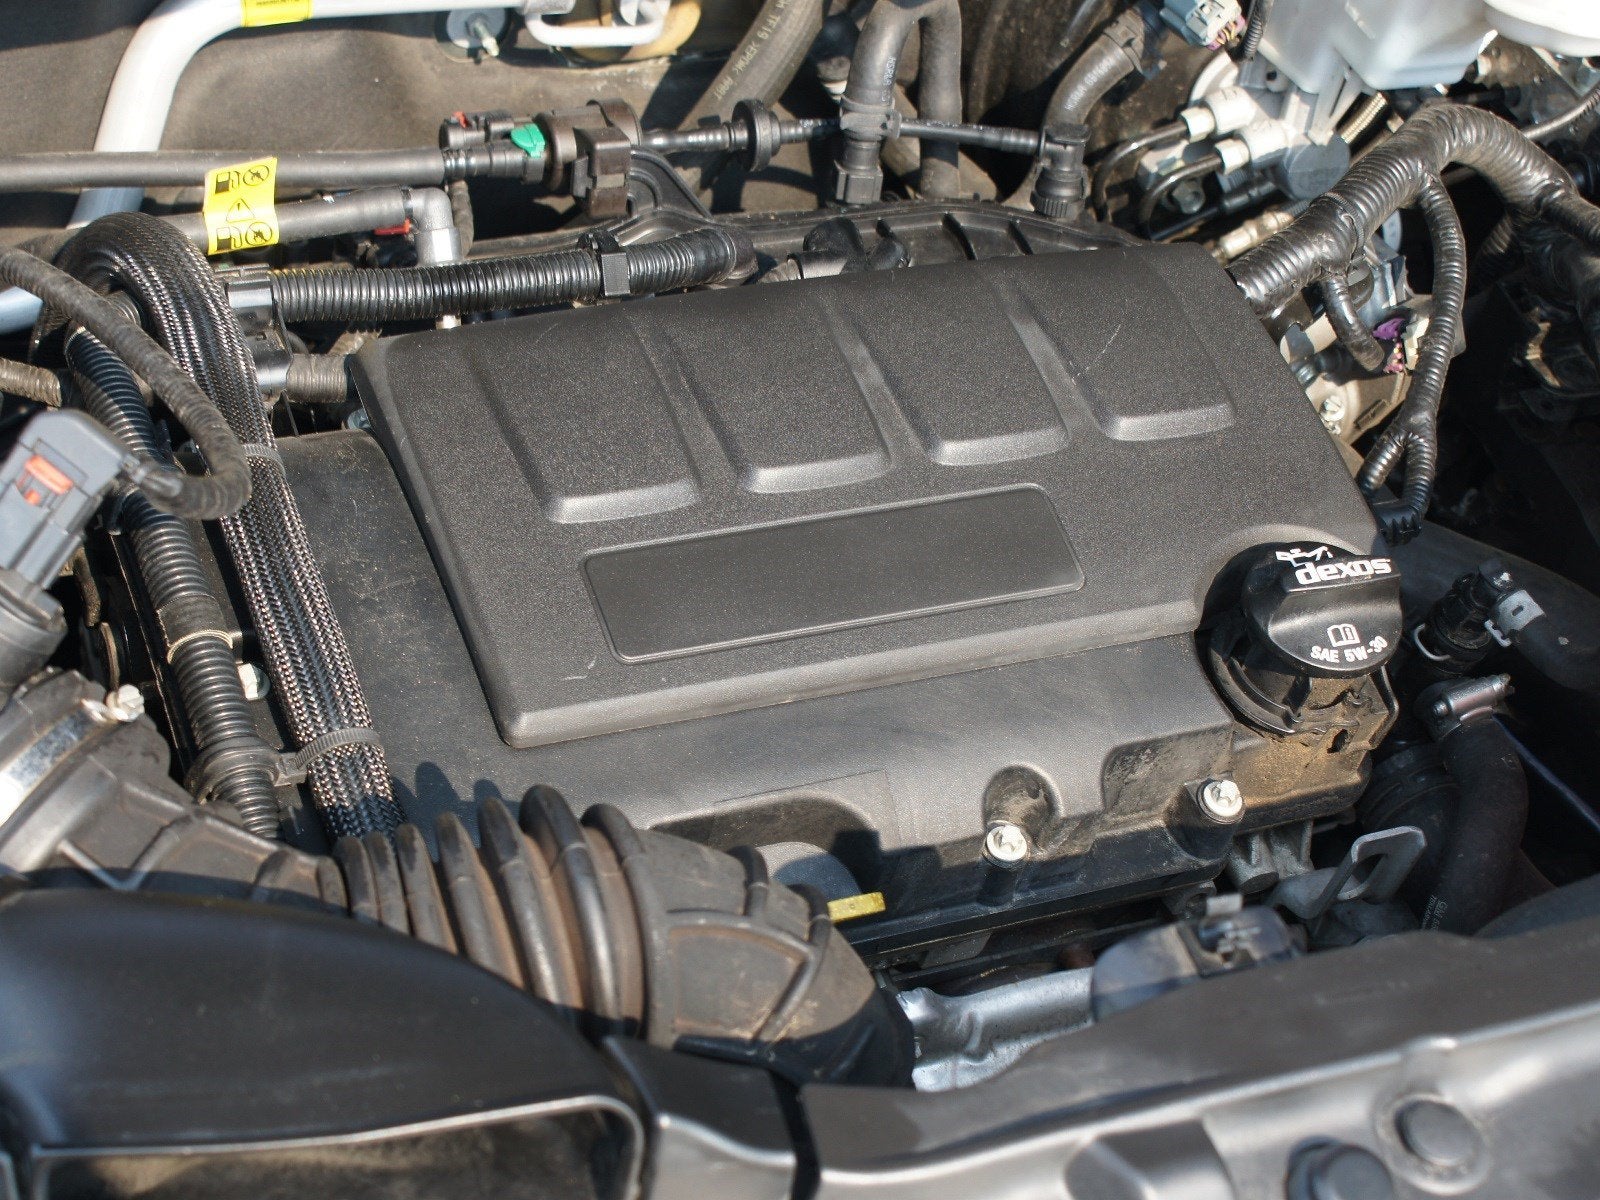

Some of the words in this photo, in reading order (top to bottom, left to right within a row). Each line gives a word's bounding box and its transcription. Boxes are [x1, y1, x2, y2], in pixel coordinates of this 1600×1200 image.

[1294, 558, 1392, 585] dexos
[1310, 645, 1340, 663] SAE
[1343, 635, 1388, 663] 5W-30
